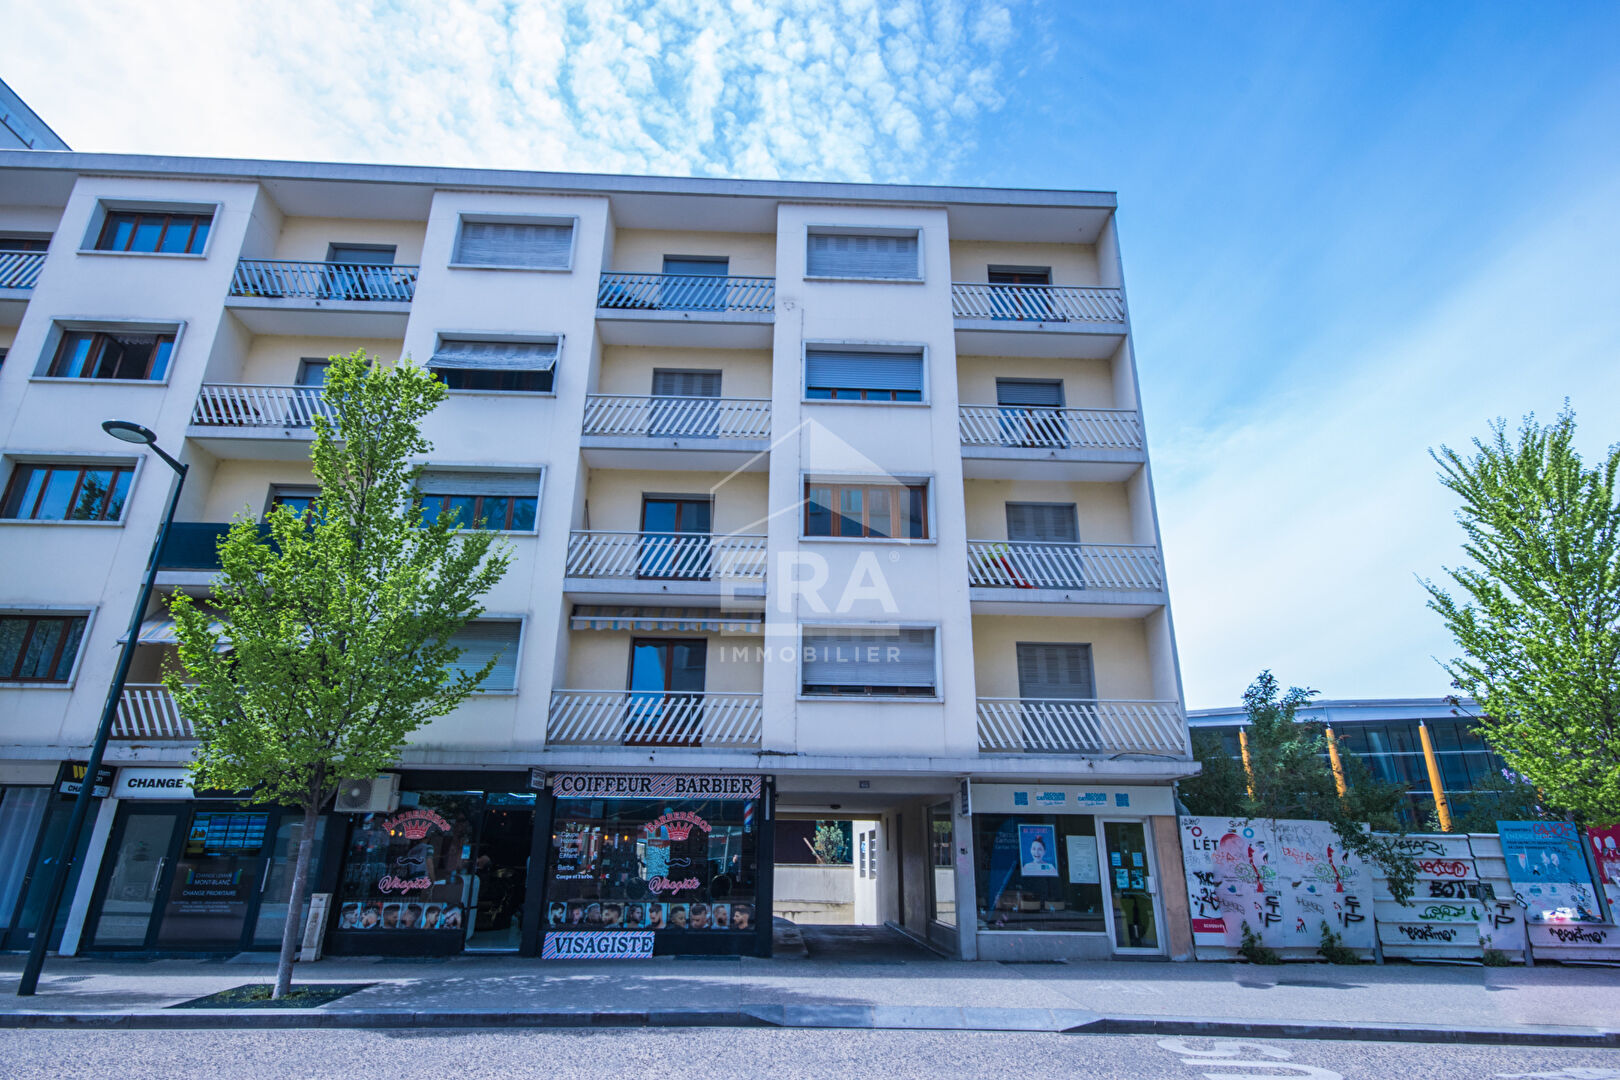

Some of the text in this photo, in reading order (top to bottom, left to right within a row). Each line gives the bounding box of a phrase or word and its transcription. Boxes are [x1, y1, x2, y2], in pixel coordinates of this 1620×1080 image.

[127, 778, 184, 789] CHANGE
[561, 776, 652, 793] COIFFEUR
[674, 777, 754, 794] BARBIER
[554, 936, 654, 954] VISAGISTE
